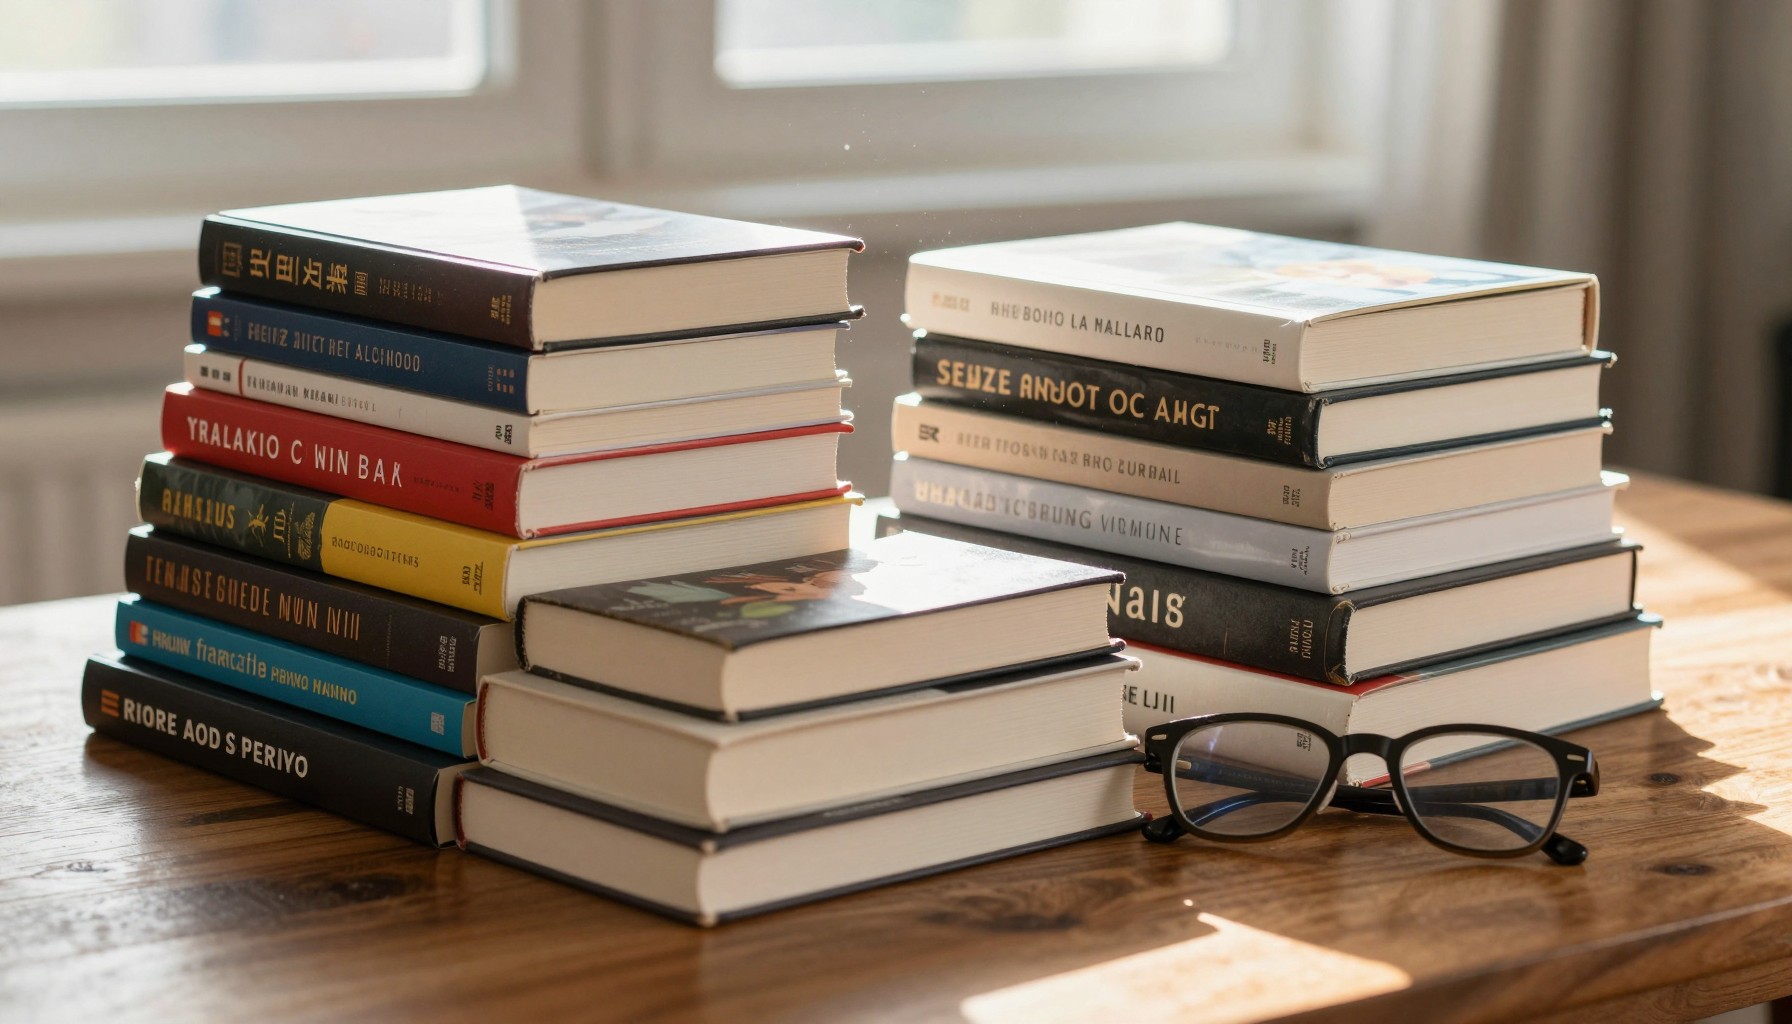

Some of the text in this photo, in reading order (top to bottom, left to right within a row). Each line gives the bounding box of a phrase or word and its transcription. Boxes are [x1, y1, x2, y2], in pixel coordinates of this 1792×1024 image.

[1108, 388, 1145, 418] OC
[291, 439, 303, 465] C
[123, 698, 178, 736] RIORE
[225, 732, 236, 755] S
